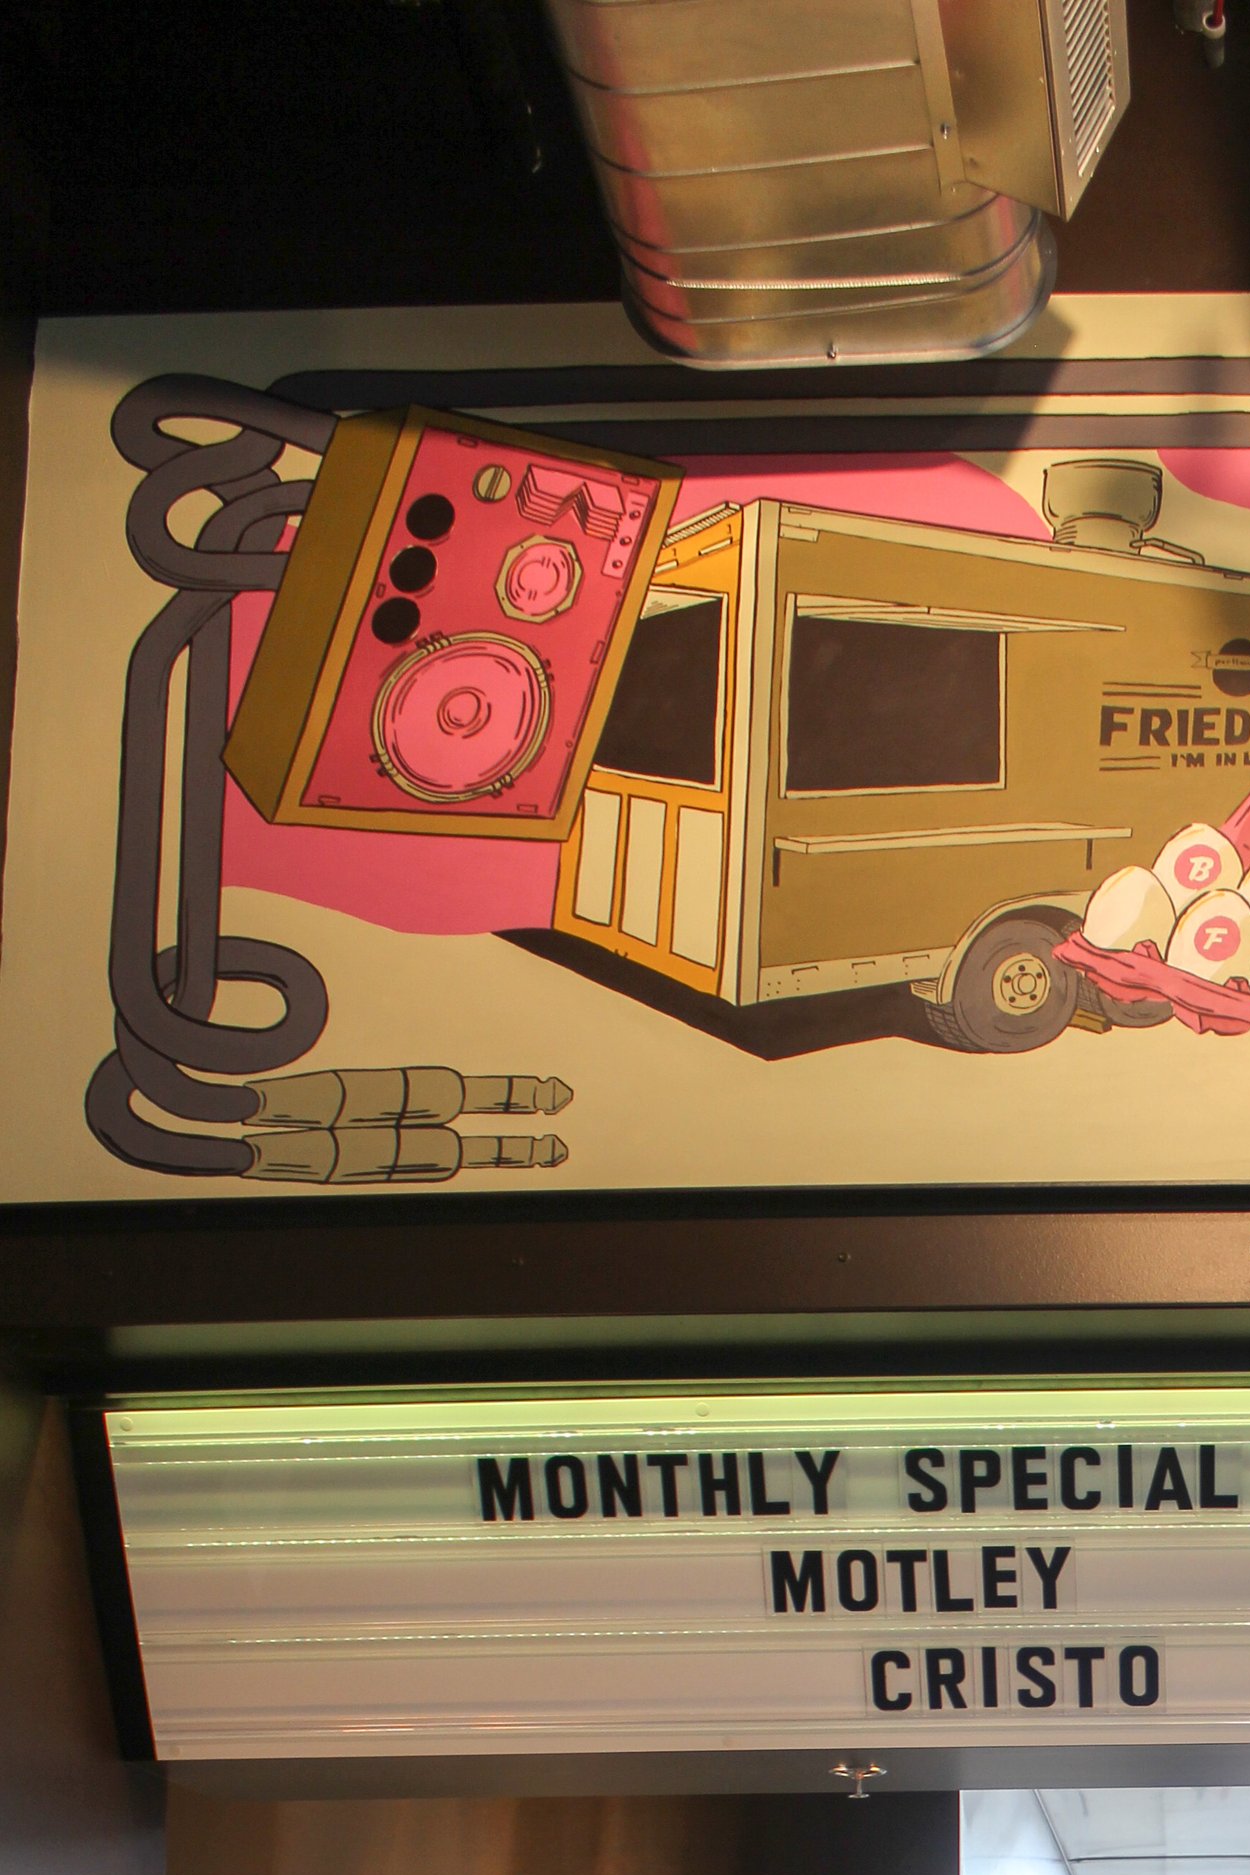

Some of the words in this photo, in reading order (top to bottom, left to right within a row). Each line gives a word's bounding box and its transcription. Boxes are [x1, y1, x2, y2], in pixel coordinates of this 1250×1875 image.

[1171, 752, 1205, 768] I'M
[1215, 752, 1238, 767] IN
[477, 1450, 841, 1522] MONTHLY
[904, 1444, 1239, 1514] SPECIAL
[770, 1545, 1072, 1613] MOTLEY
[871, 1645, 1159, 1711] CRISTO
